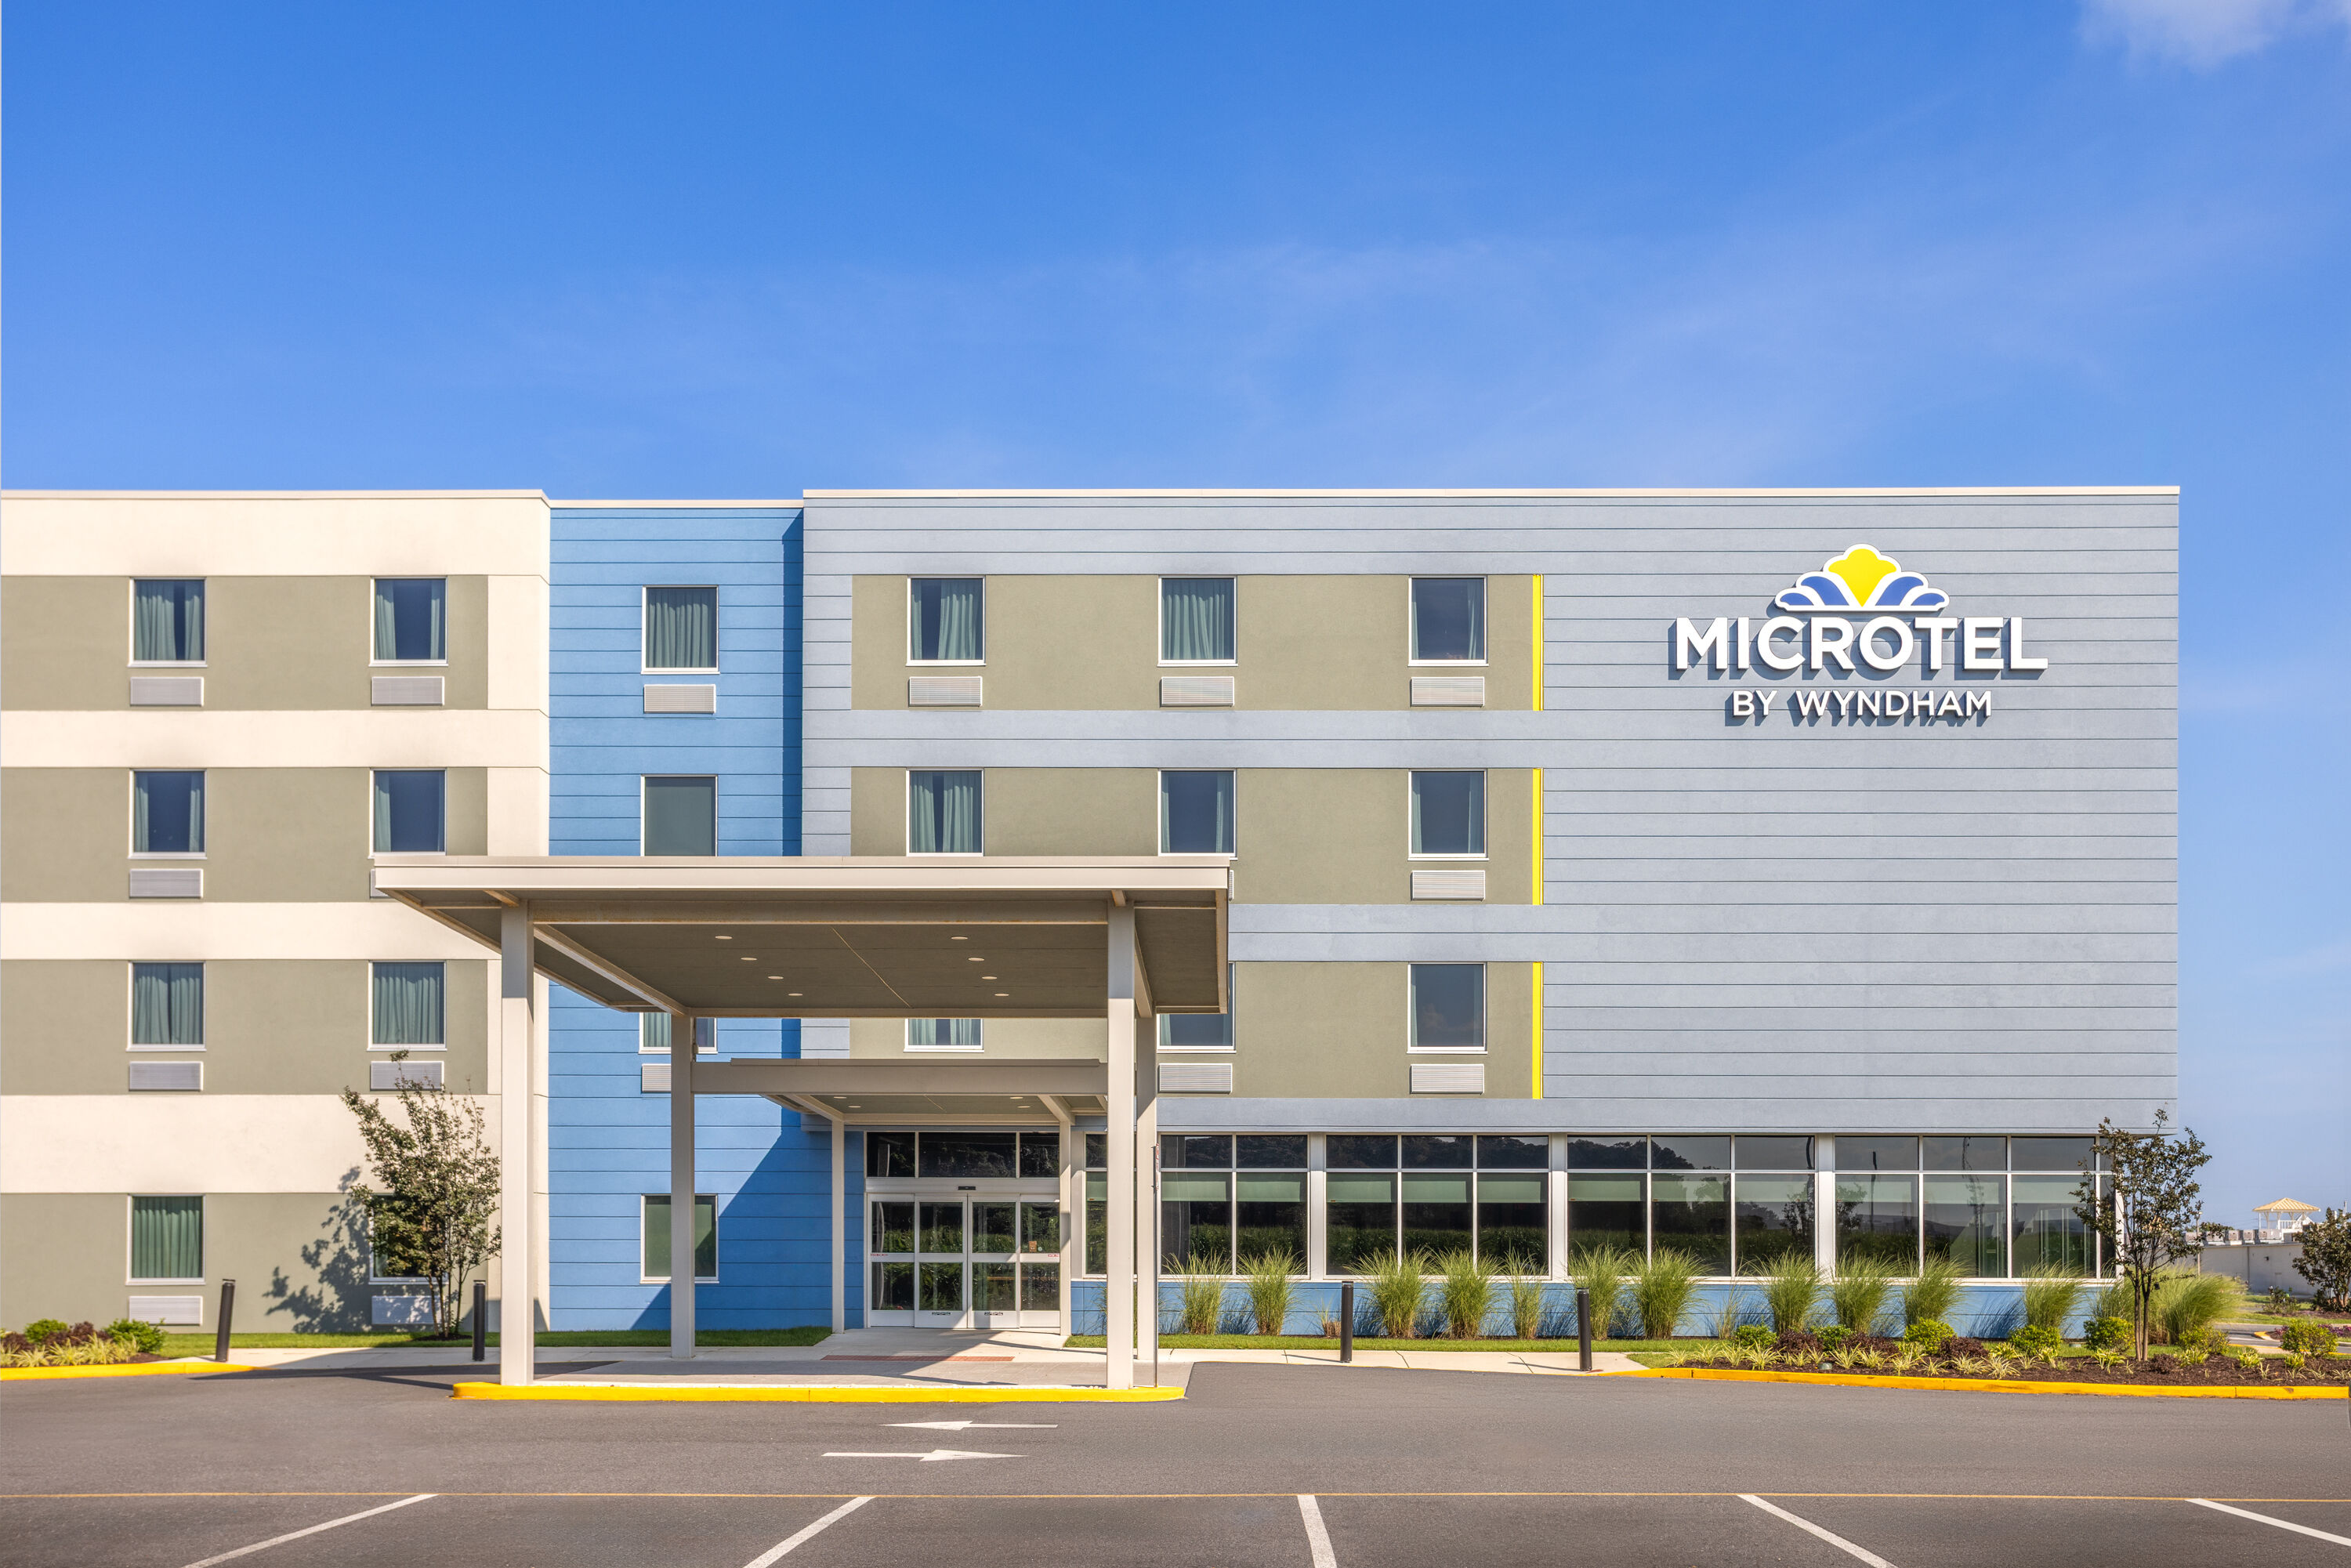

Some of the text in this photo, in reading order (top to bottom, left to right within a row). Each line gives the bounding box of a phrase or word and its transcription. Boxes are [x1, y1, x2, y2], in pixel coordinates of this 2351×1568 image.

[1675, 615, 2049, 671] MICROTEL
[1732, 690, 1993, 717] BY WYNDHAM
